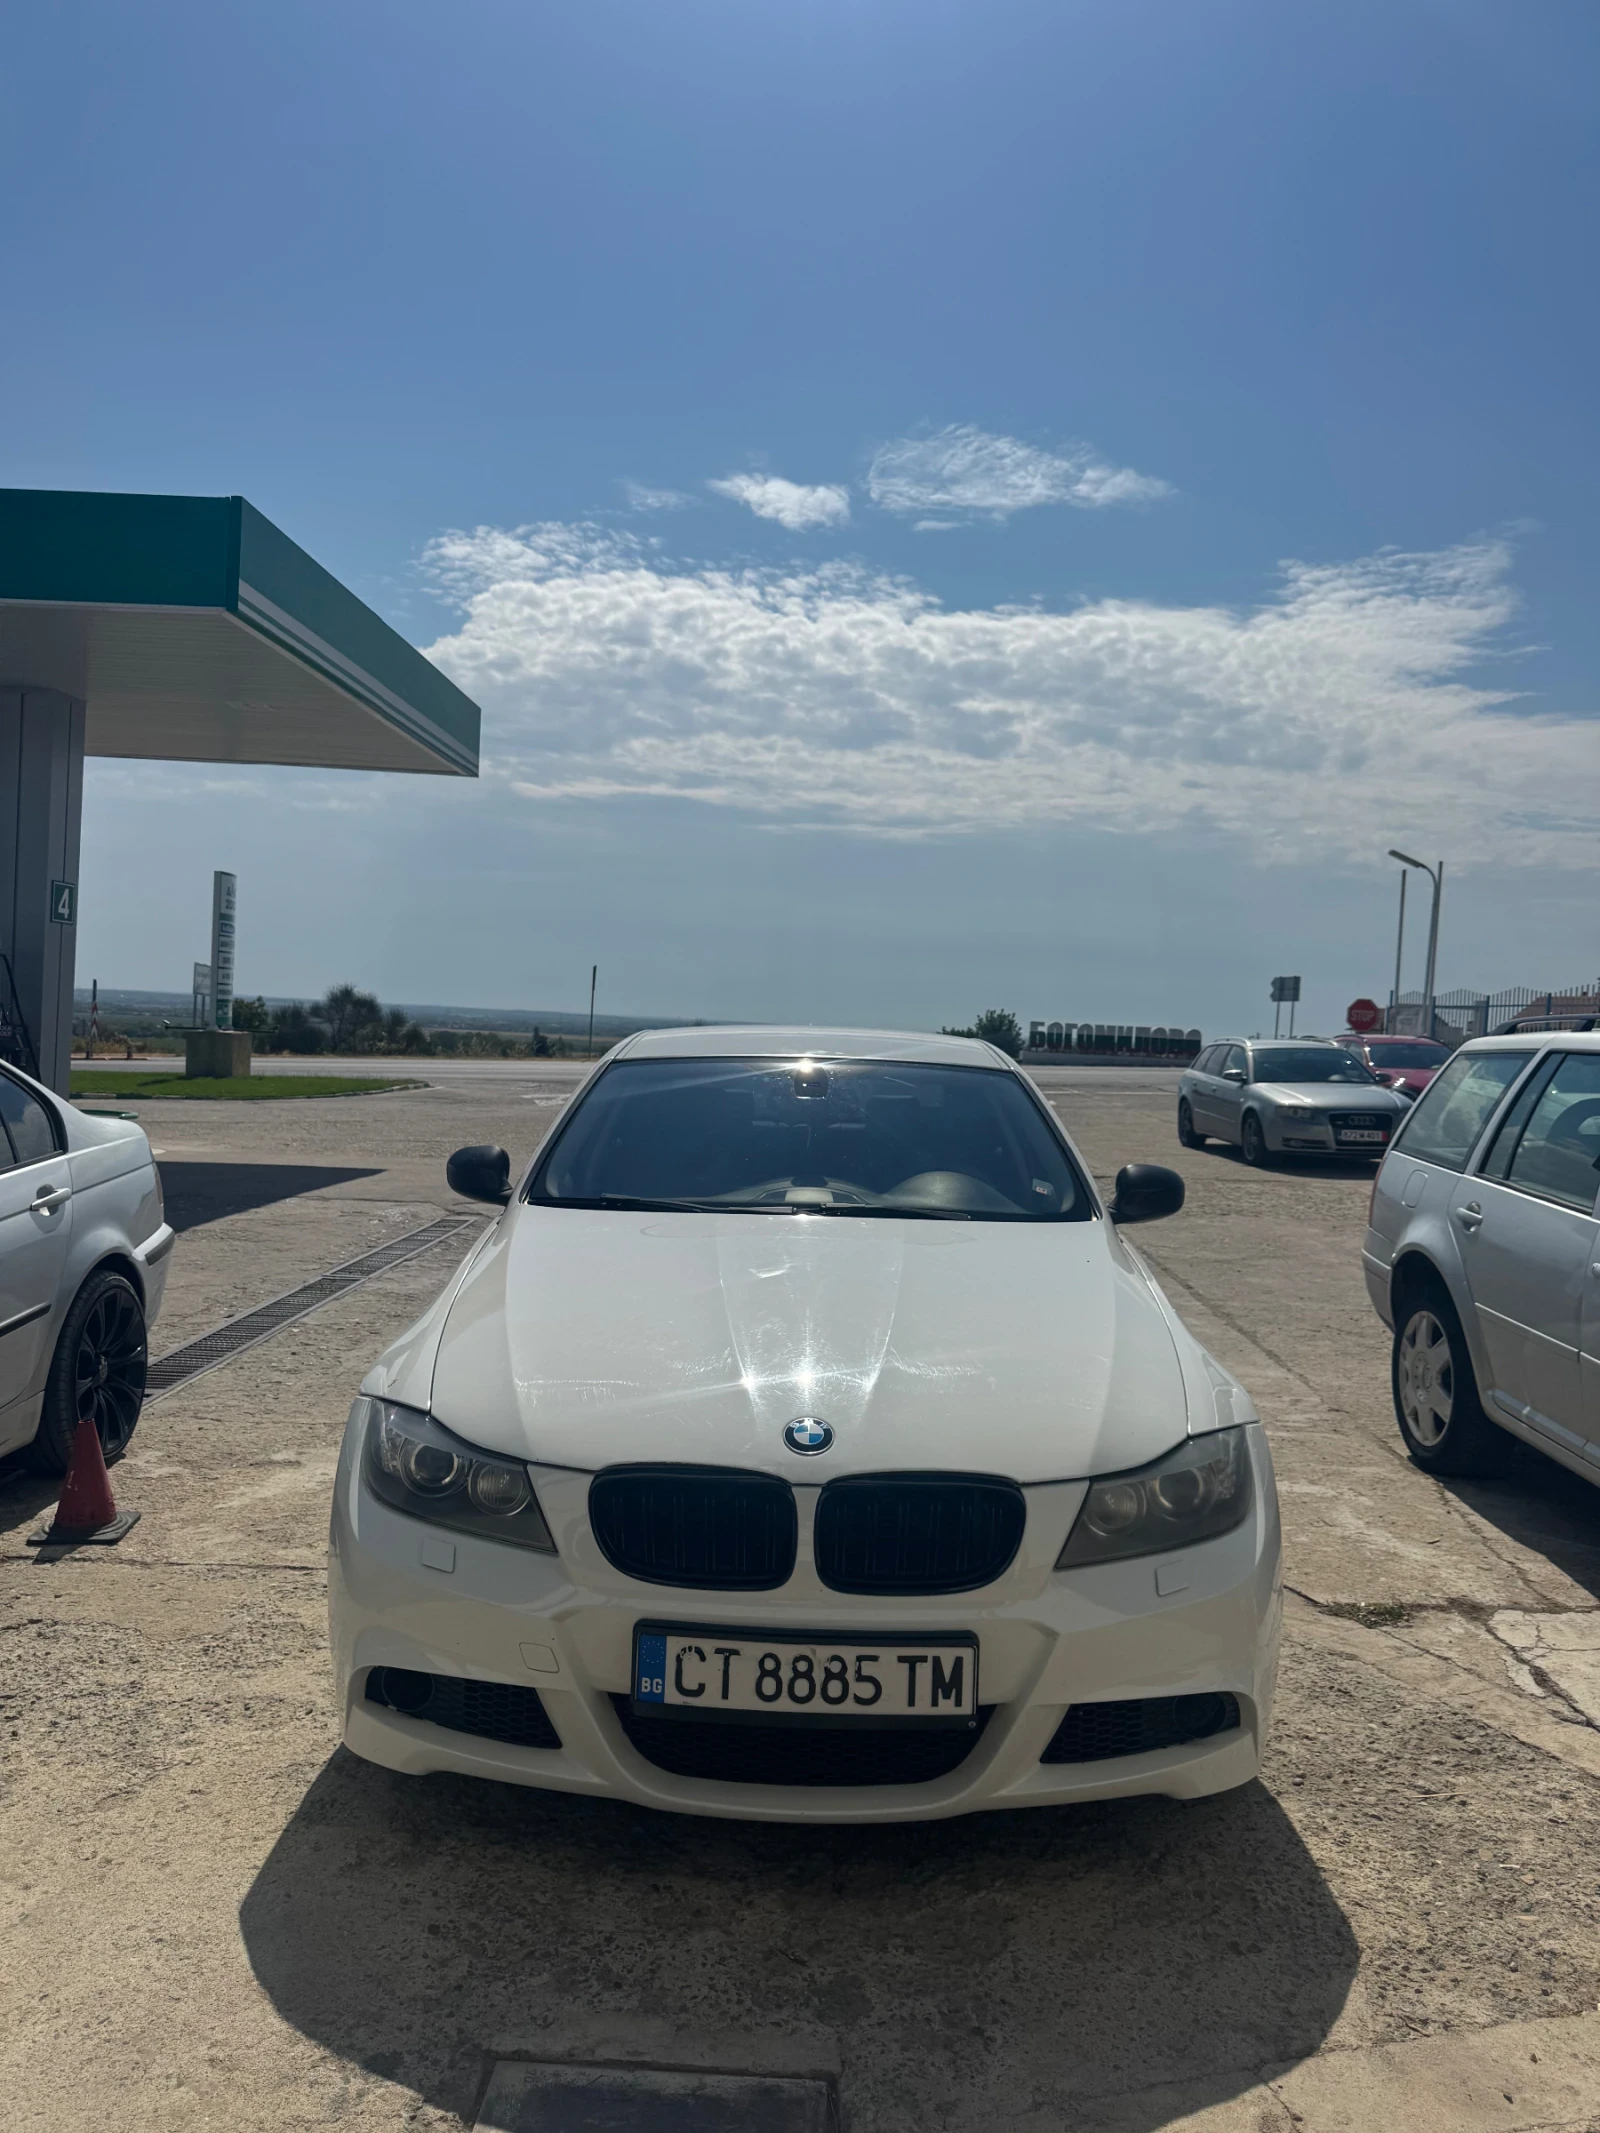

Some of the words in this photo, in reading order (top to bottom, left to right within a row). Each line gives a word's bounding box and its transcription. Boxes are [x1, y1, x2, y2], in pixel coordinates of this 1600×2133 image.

[58, 888, 69, 919] 4
[1350, 1009, 1375, 1022] STOP
[1029, 1020, 1202, 1055] БОГОМИЛОВО
[641, 1677, 662, 1693] BG
[674, 1645, 741, 1700] CT
[755, 1651, 882, 1706] 8885
[897, 1655, 964, 1707] TM
